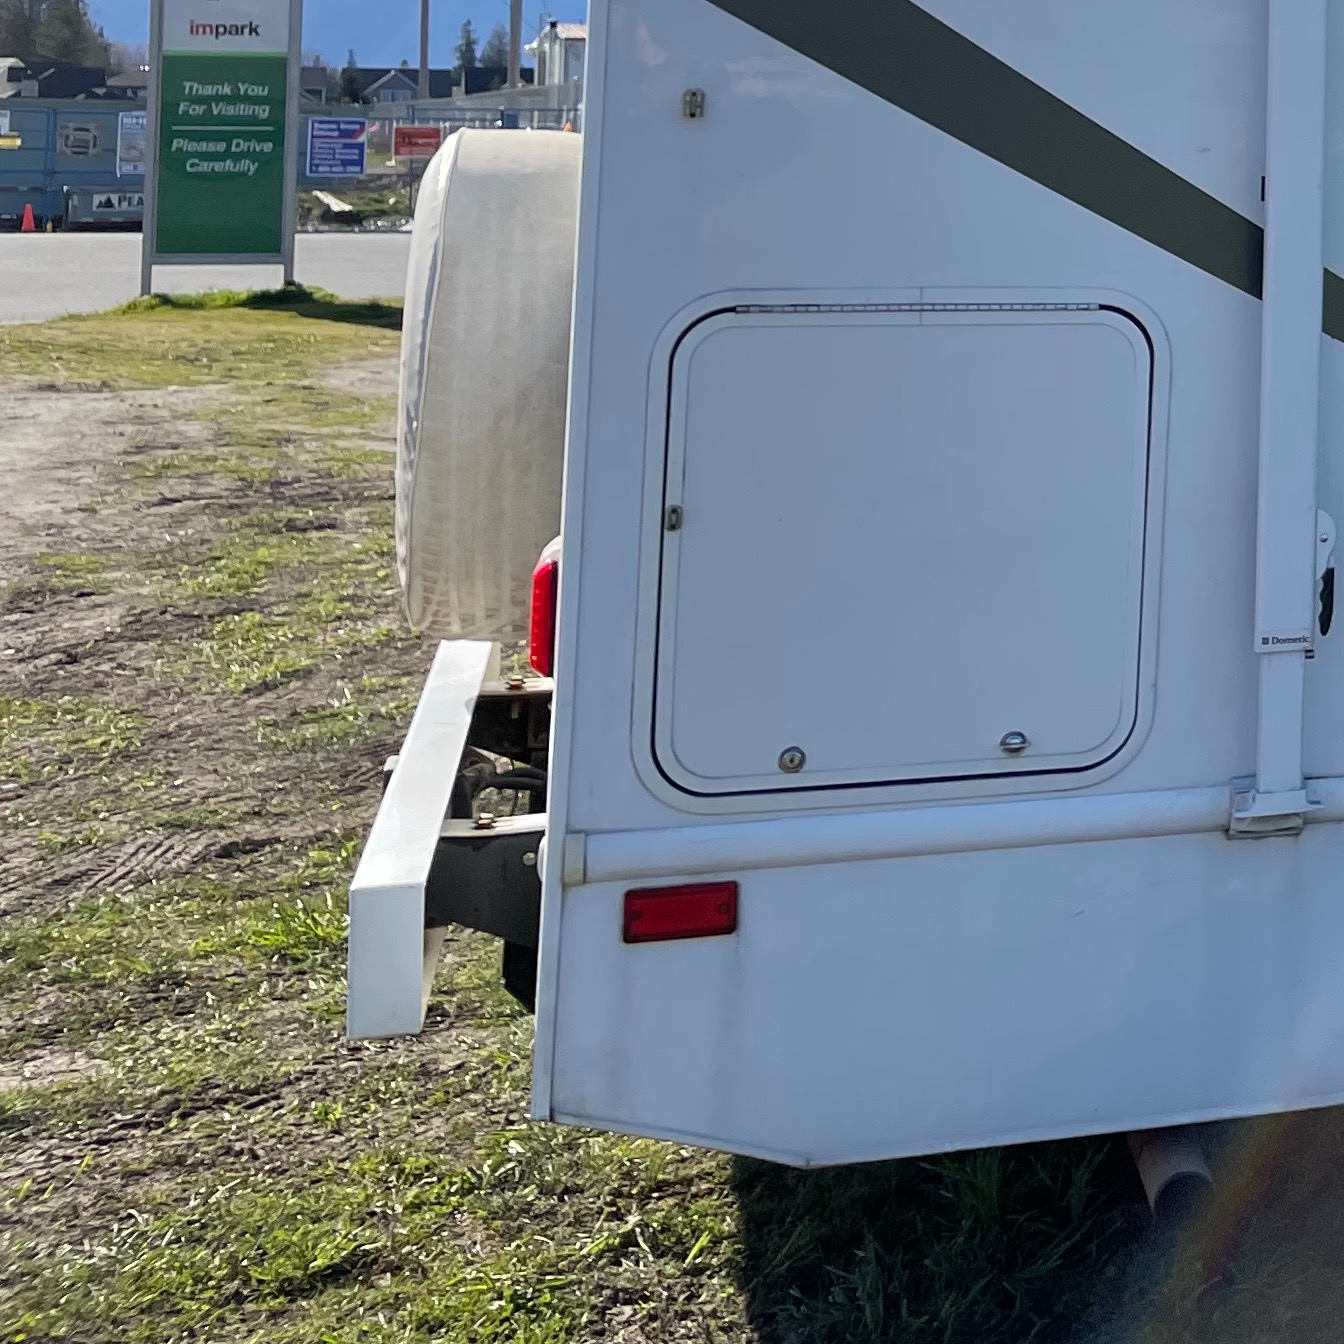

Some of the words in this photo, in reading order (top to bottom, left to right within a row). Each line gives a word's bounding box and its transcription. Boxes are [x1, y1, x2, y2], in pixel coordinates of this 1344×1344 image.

[189, 19, 261, 40] impark
[183, 81, 232, 96] Thank
[238, 82, 269, 96] You
[178, 102, 208, 116] For
[211, 101, 270, 119] Visiting
[171, 138, 226, 153] Please
[231, 138, 273, 153] Drive
[185, 158, 259, 176] Carefully
[1271, 636, 1310, 645] Dometic
